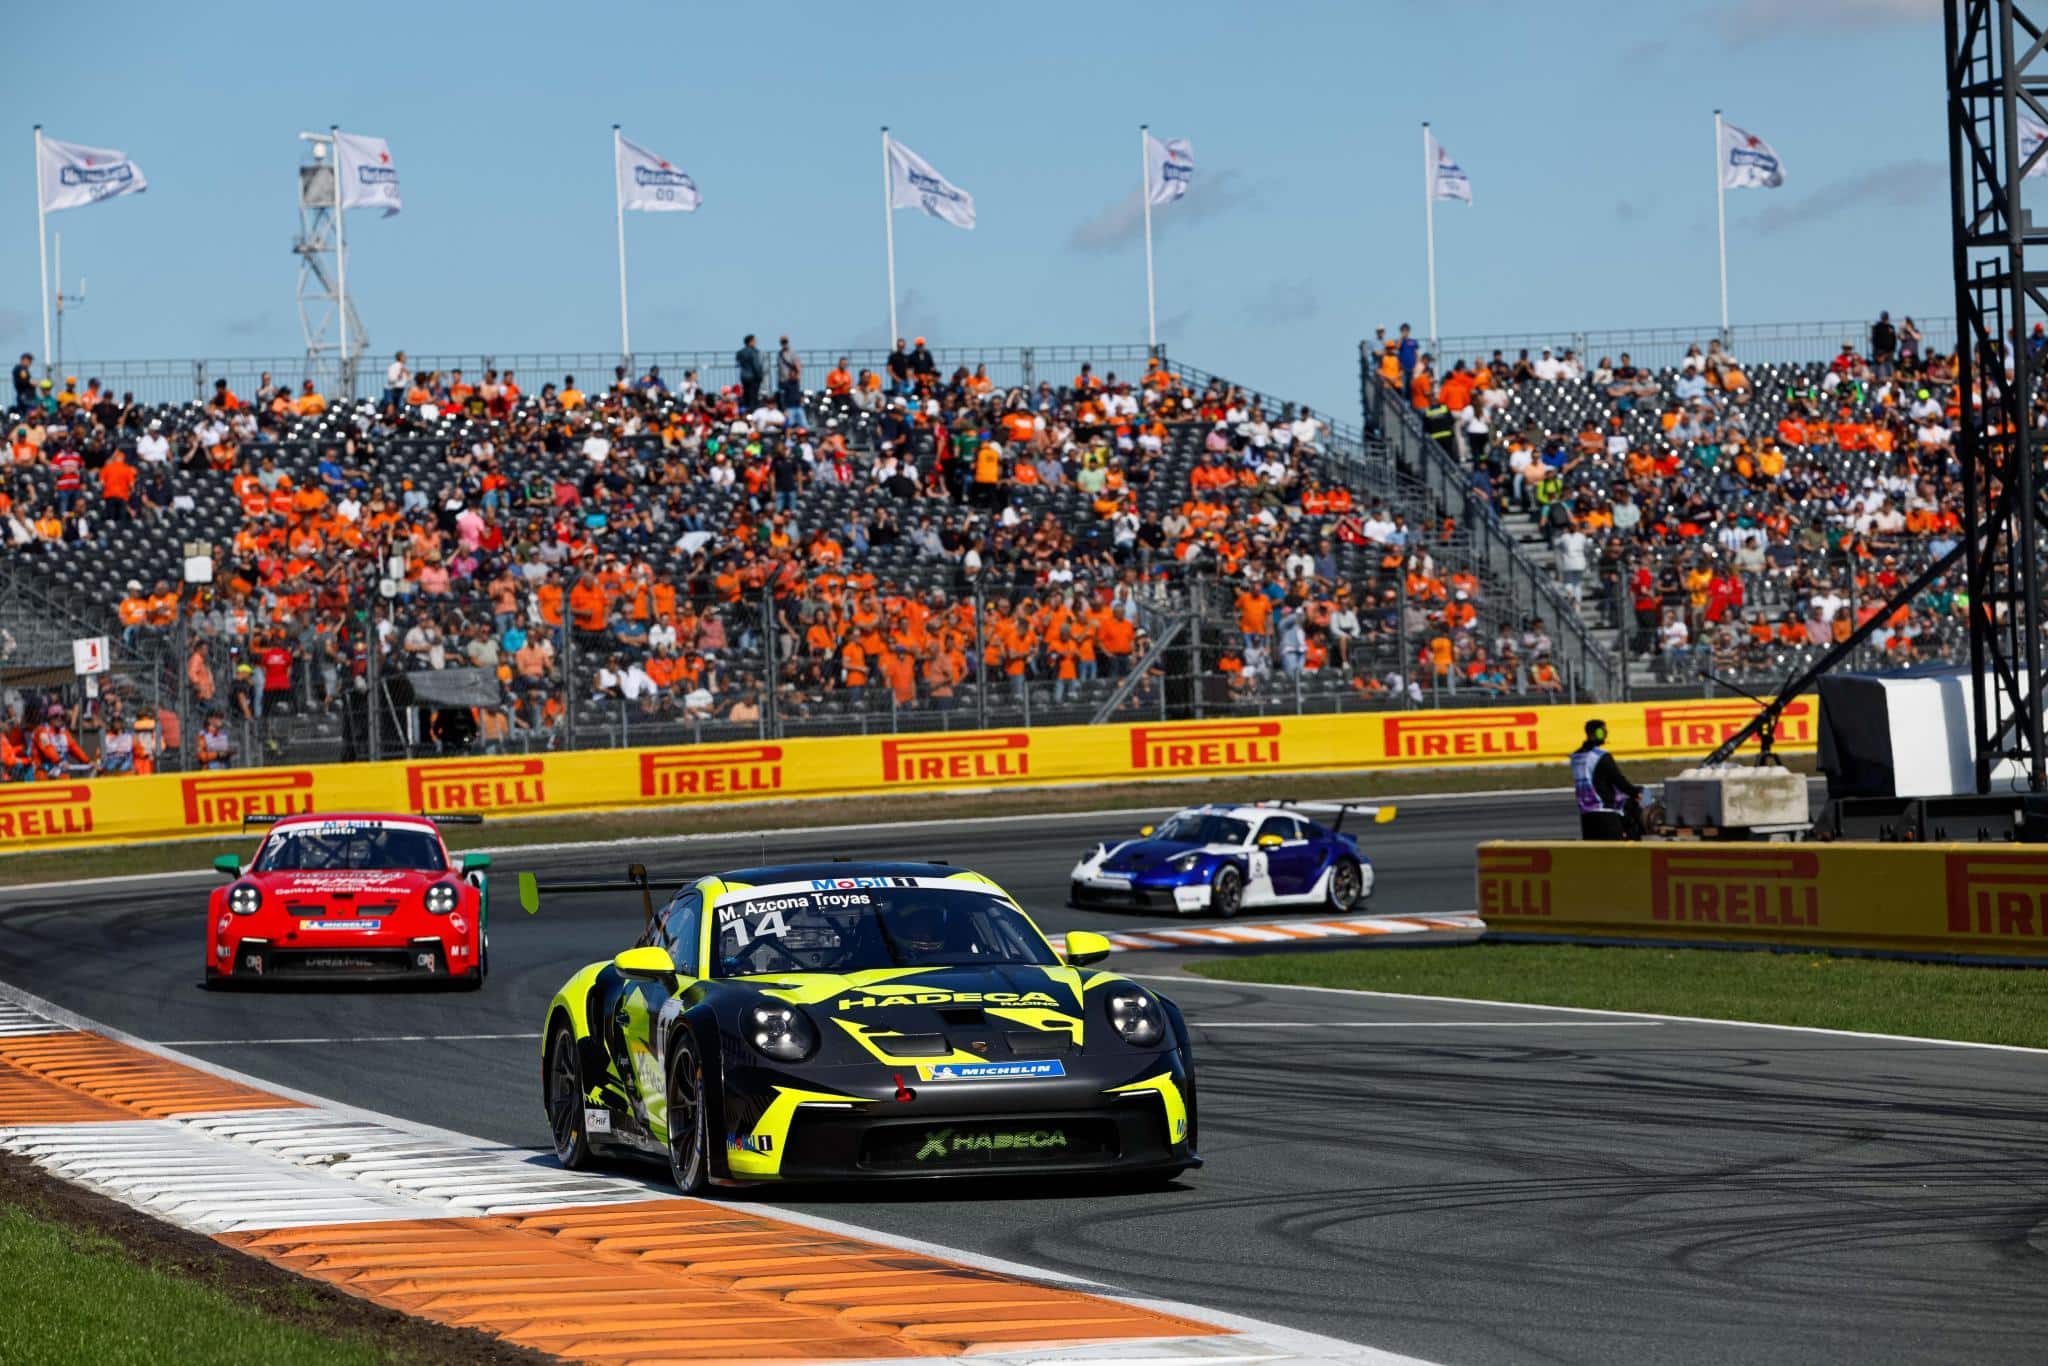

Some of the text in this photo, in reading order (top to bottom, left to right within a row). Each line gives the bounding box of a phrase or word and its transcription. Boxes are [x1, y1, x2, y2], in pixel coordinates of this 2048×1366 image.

[1131, 723, 1280, 769] PIRELLI
[1384, 713, 1538, 757] PIRELLI
[640, 746, 782, 796] PIRELLI
[882, 734, 1029, 782] PIRELLI
[407, 760, 543, 812] PIRELLI
[811, 877, 888, 891] Mobil
[1651, 850, 1819, 926] PIRELLI
[718, 893, 871, 922] M. Azcona Troyas
[721, 910, 791, 947] 14
[839, 992, 1057, 1010] HADECA
[962, 1065, 1050, 1076] MICHELIN
[953, 1130, 1067, 1150] HADECA
